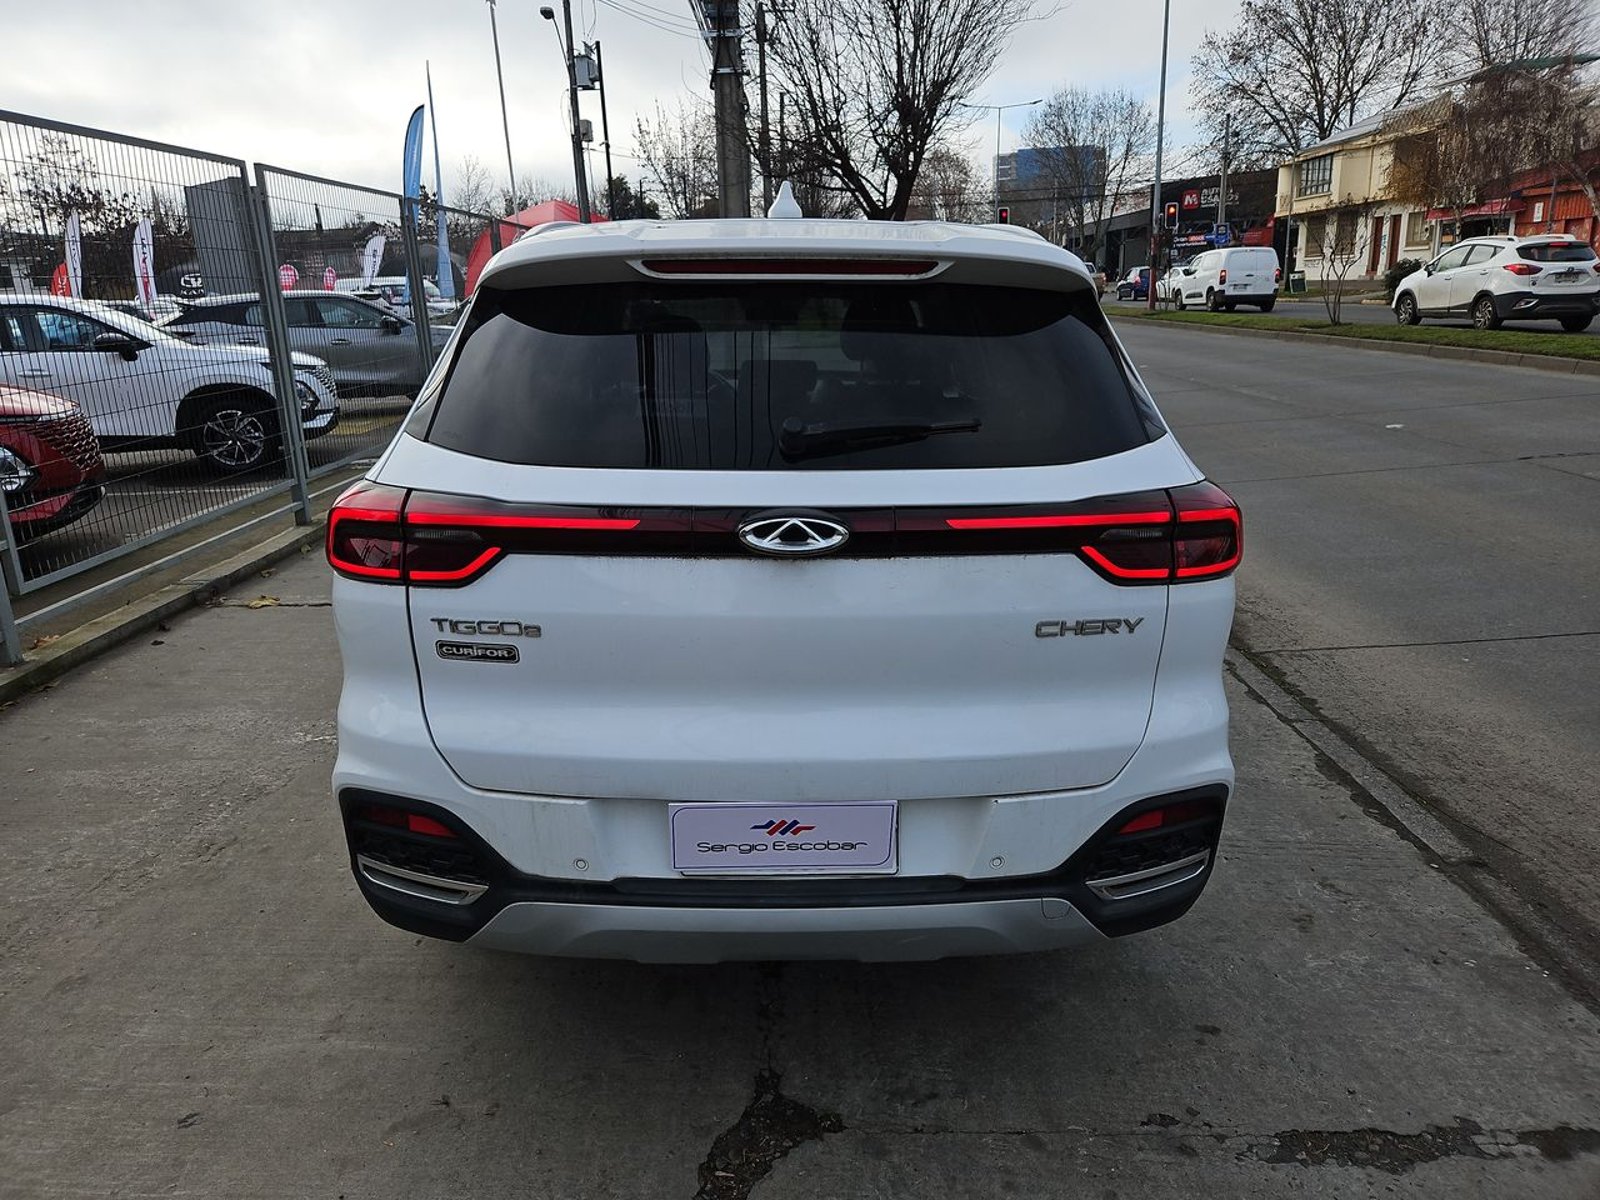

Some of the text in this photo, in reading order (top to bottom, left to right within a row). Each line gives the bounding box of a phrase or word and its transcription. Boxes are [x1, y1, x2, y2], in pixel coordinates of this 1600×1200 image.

[1035, 617, 1145, 638] CHERY
[441, 645, 510, 657] CURIFOR
[697, 839, 868, 855] Sergio Escobar
